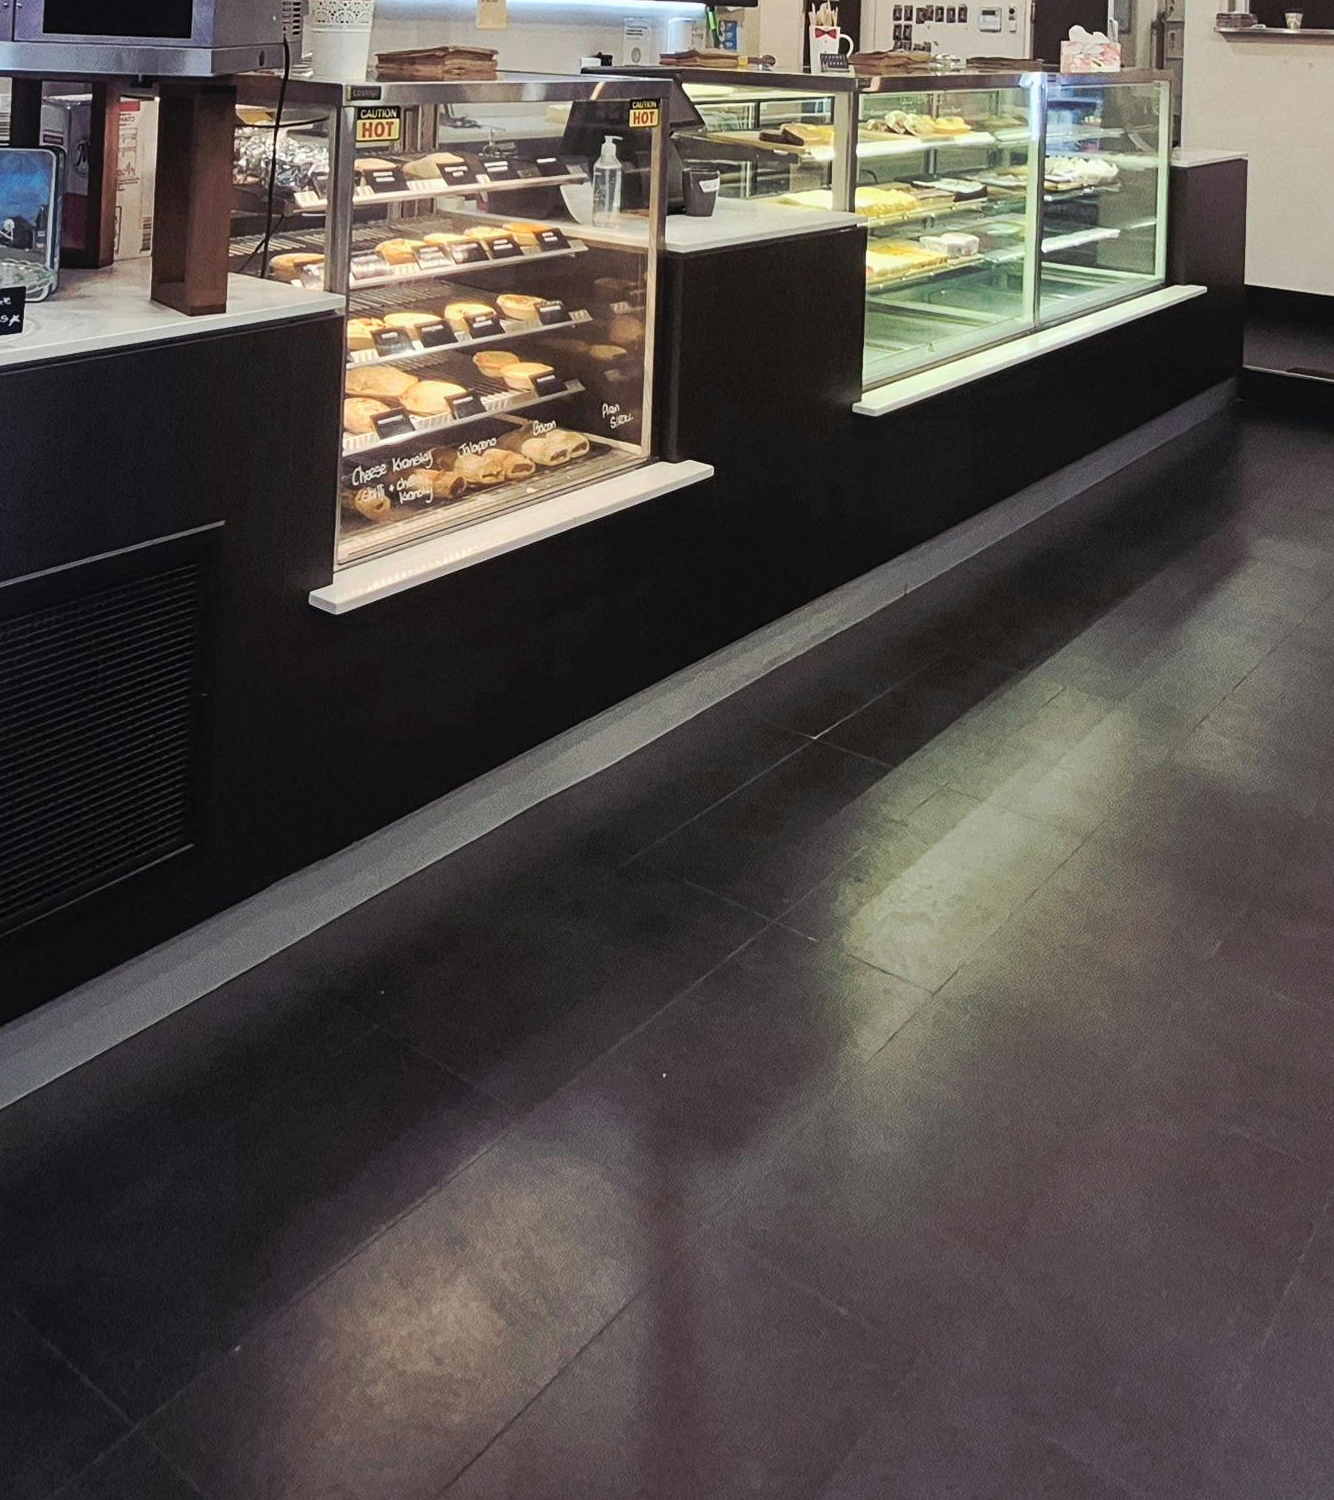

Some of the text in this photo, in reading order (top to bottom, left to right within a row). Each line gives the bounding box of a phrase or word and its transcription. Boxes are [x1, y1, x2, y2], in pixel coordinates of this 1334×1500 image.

[632, 101, 658, 109] CAUTION
[360, 108, 398, 119] CAUTION
[633, 111, 655, 125] HOT
[361, 121, 395, 138] HOT
[532, 420, 557, 437] Bacon
[351, 463, 388, 487] Cheese
